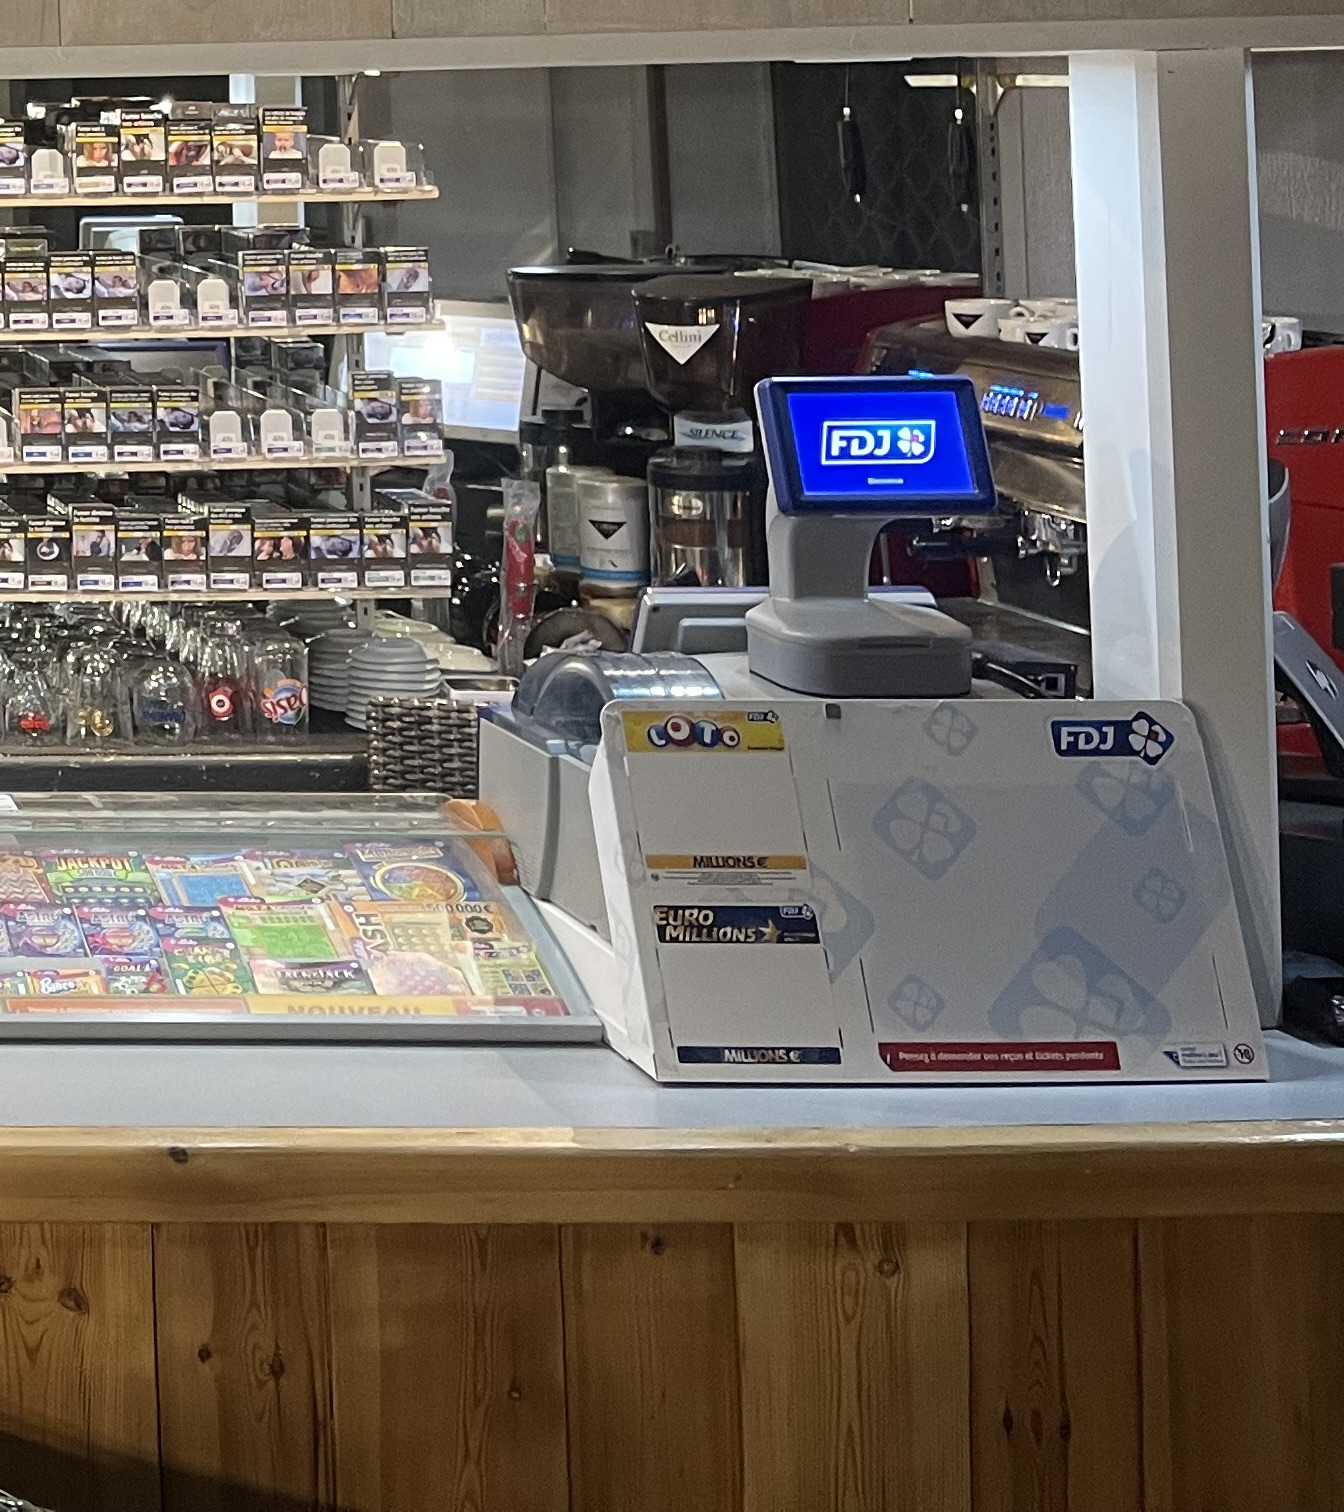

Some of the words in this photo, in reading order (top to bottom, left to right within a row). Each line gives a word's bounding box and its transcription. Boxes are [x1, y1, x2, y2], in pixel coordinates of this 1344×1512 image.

[658, 329, 702, 343] Cellini
[689, 427, 737, 439] SILENCE
[830, 430, 891, 456] FDJ
[748, 712, 764, 721] FDJ
[648, 715, 740, 747] LOTO
[1059, 725, 1117, 751] FDJ
[56, 855, 132, 871] JACKPOT
[692, 855, 755, 869] MILLIONS
[653, 906, 714, 926] EURO
[353, 912, 390, 955] ASH
[665, 925, 756, 942] MILLIONS
[40, 977, 74, 994] Banco
[287, 1005, 421, 1016] NOUVEAU
[723, 1048, 788, 1063] MILLIONS
